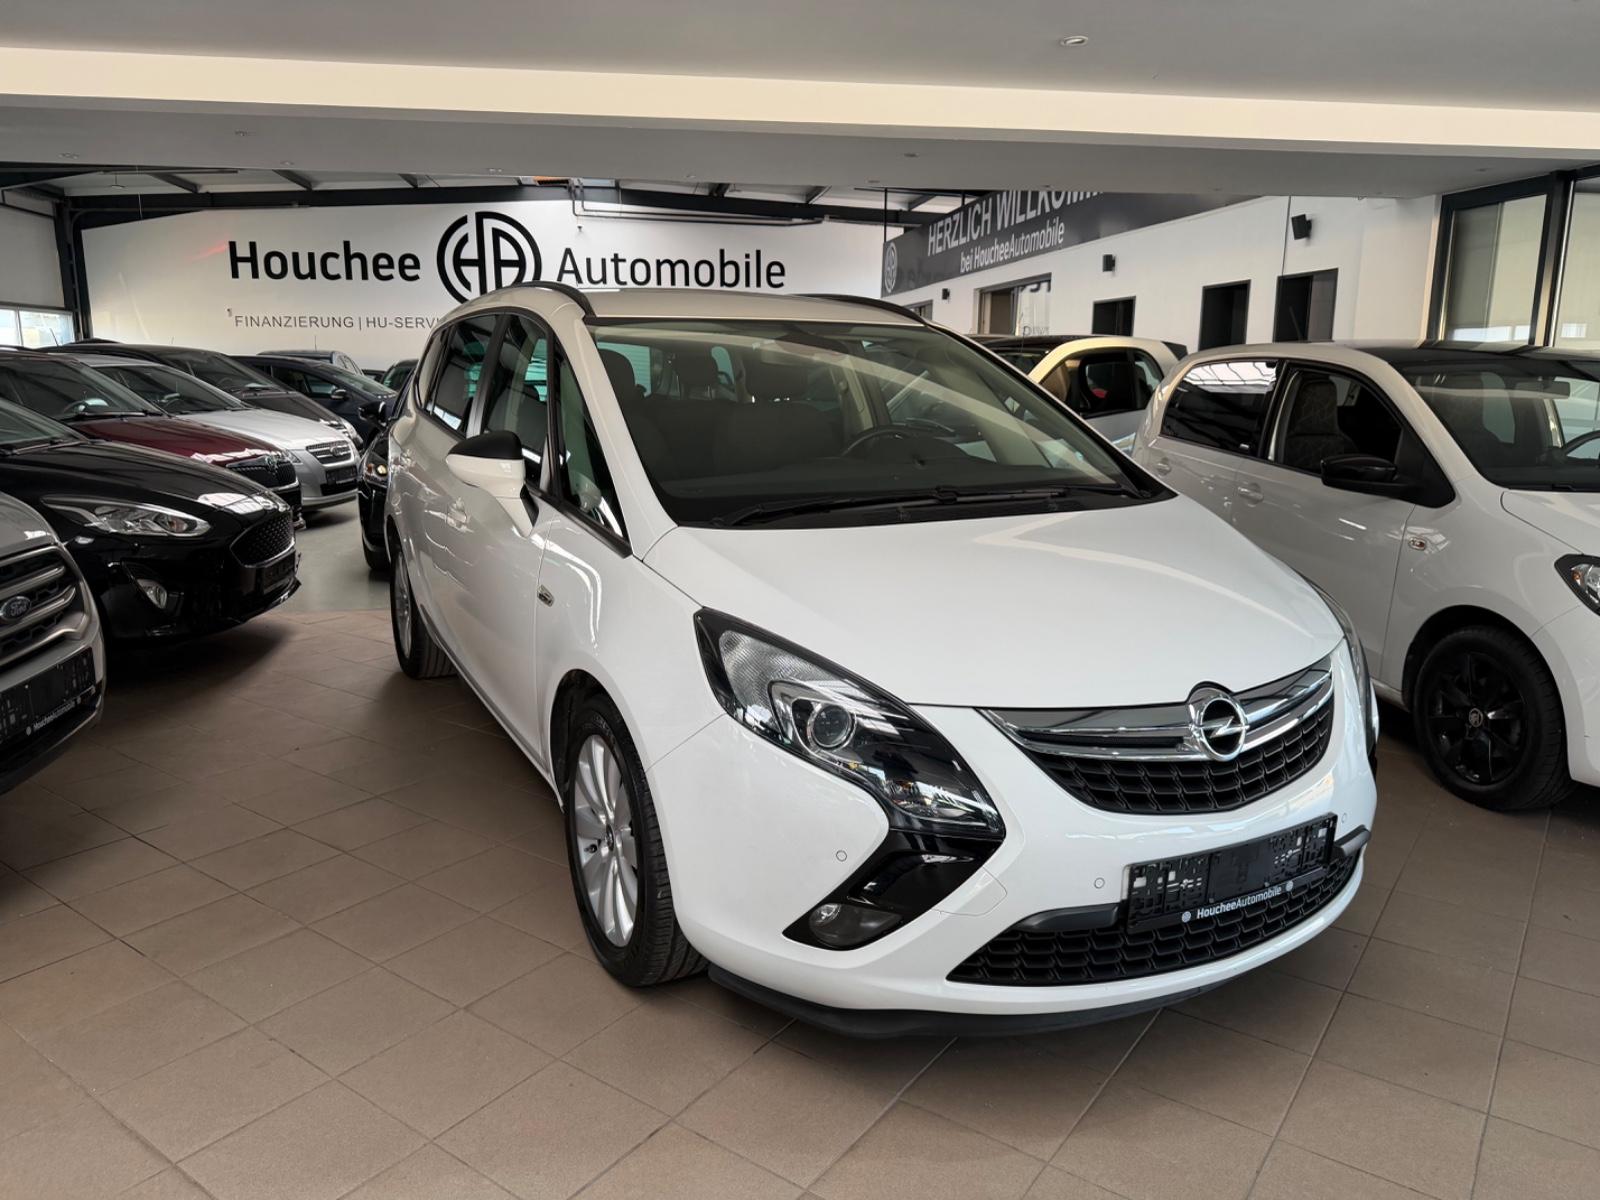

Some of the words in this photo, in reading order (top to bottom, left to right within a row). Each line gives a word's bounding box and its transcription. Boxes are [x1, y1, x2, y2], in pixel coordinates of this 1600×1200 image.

[927, 197, 993, 257] HERZLICH
[996, 190, 1104, 231] WILLK
[228, 240, 421, 282] Houchee
[556, 247, 786, 289] Automobile
[960, 250, 973, 273] bei
[234, 315, 354, 328] FINANZIERUNG
[1196, 885, 1282, 919] HoucheeAutomobile
